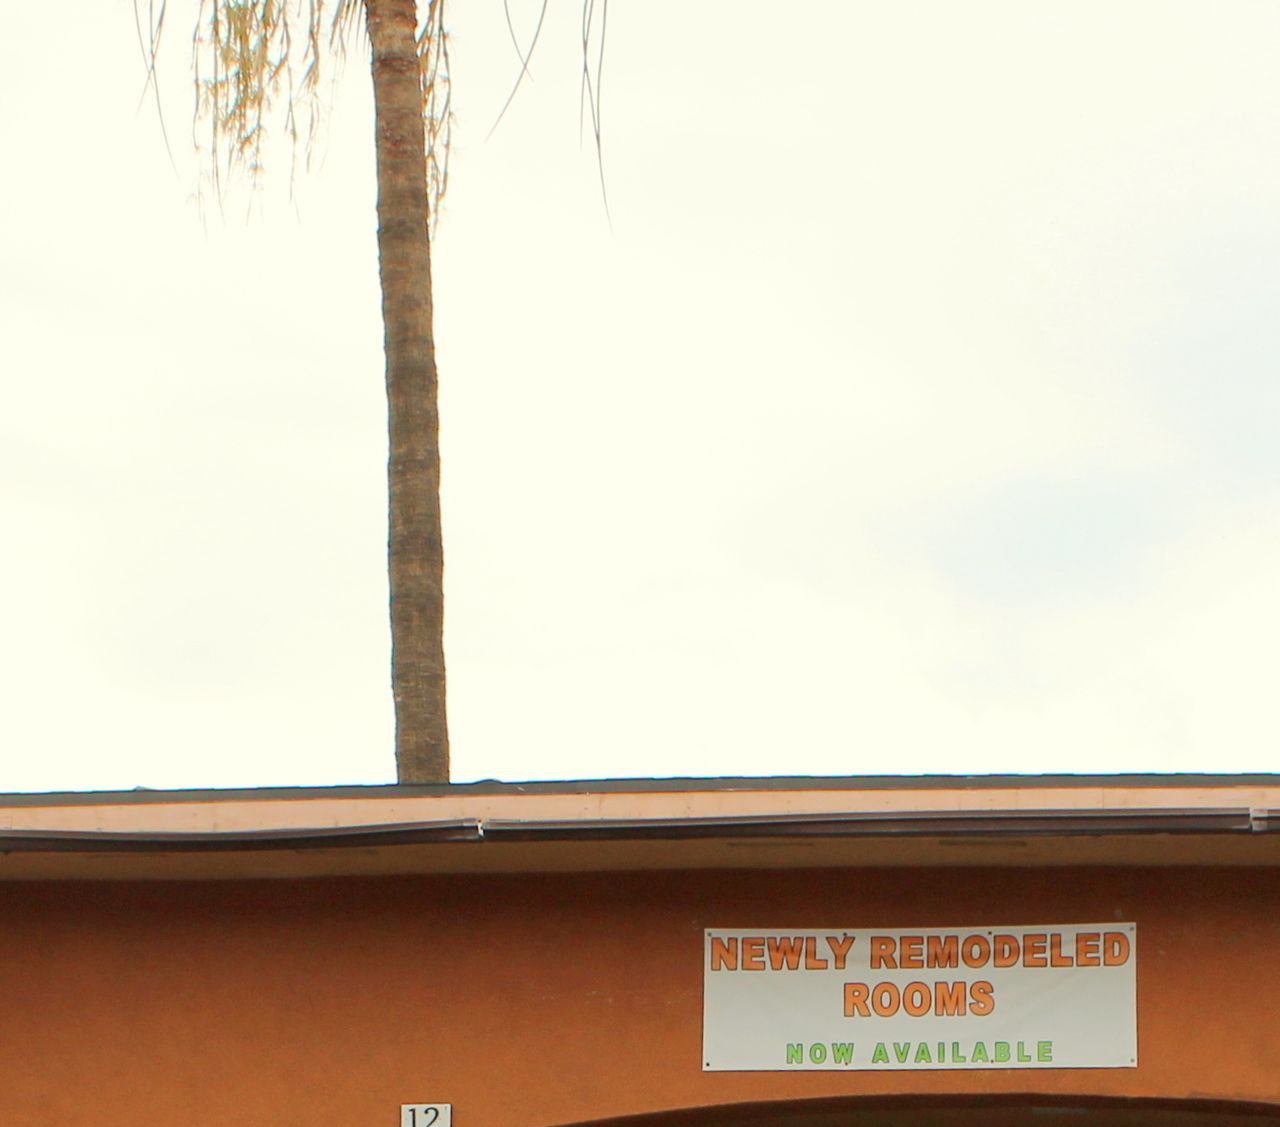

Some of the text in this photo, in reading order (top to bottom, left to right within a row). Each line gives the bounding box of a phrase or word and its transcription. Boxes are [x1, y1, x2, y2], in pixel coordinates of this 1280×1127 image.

[711, 932, 1130, 971] NEWLY REMODELED
[843, 981, 995, 1017] ROOMS
[786, 1041, 1053, 1064] NOW AVAILABLE
